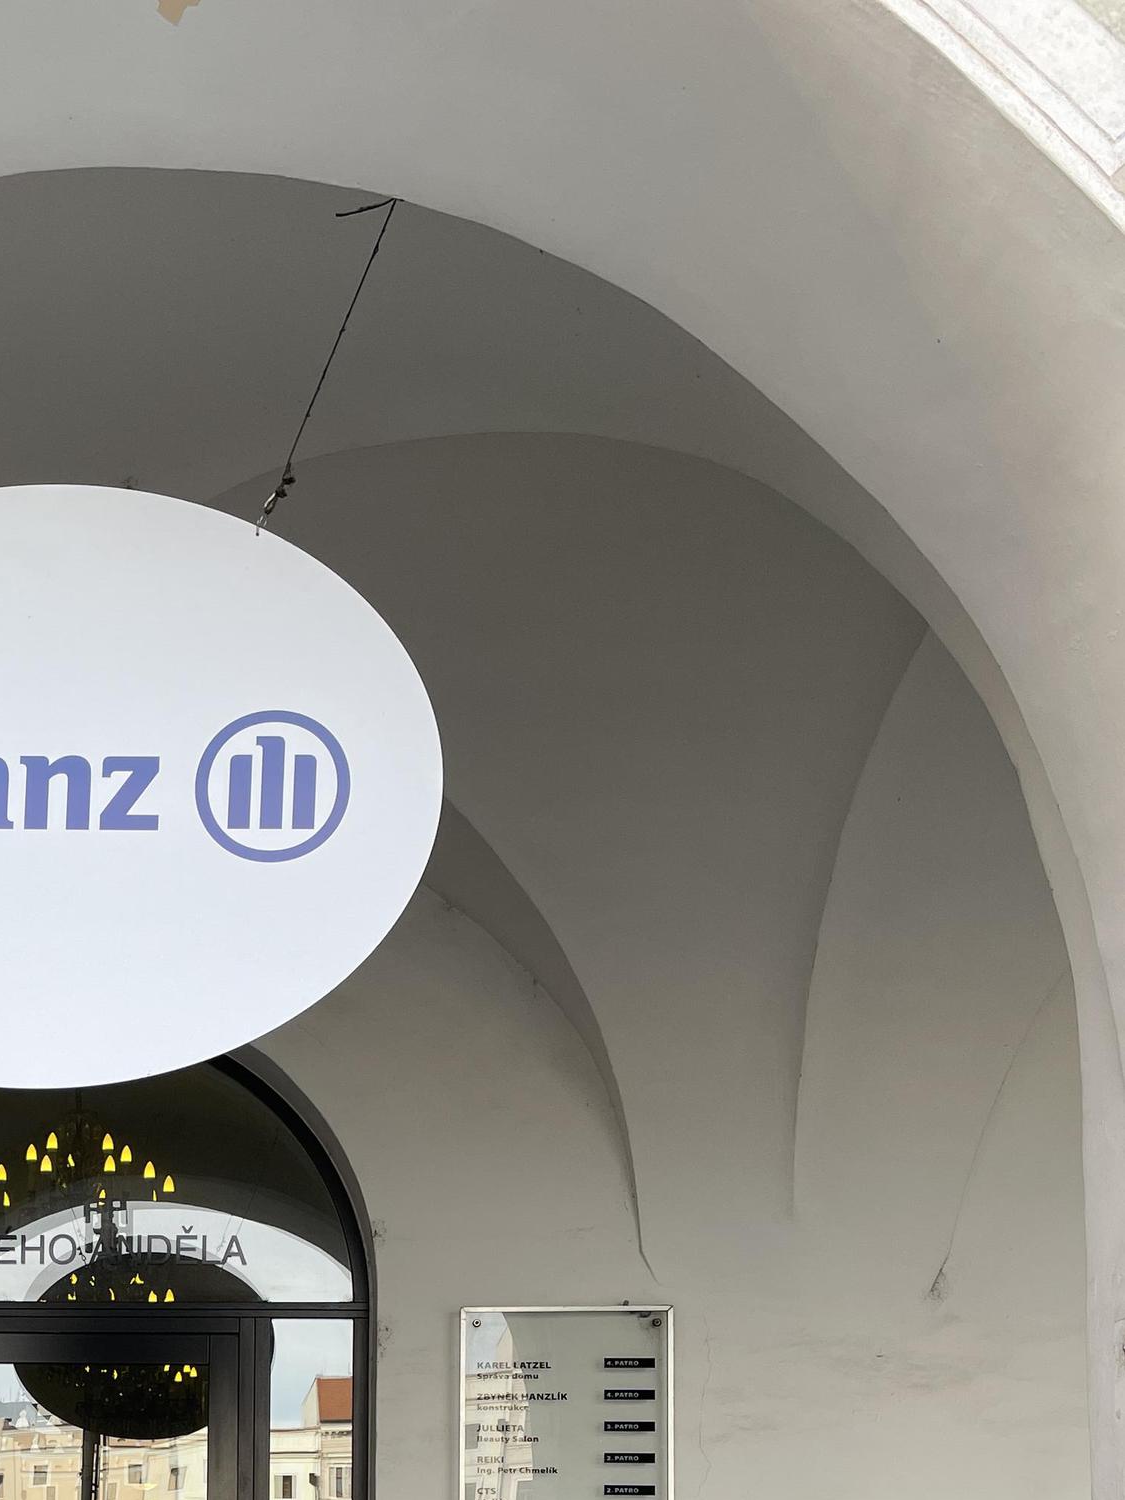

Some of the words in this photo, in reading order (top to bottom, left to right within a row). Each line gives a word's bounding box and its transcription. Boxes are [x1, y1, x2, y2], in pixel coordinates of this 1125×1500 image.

[477, 1361, 511, 1369] KAREL
[513, 1361, 552, 1369] LATZEL
[521, 1391, 568, 1401] HANZLÍK
[512, 1435, 539, 1443] Salon
[519, 1466, 558, 1474] Chmelík
